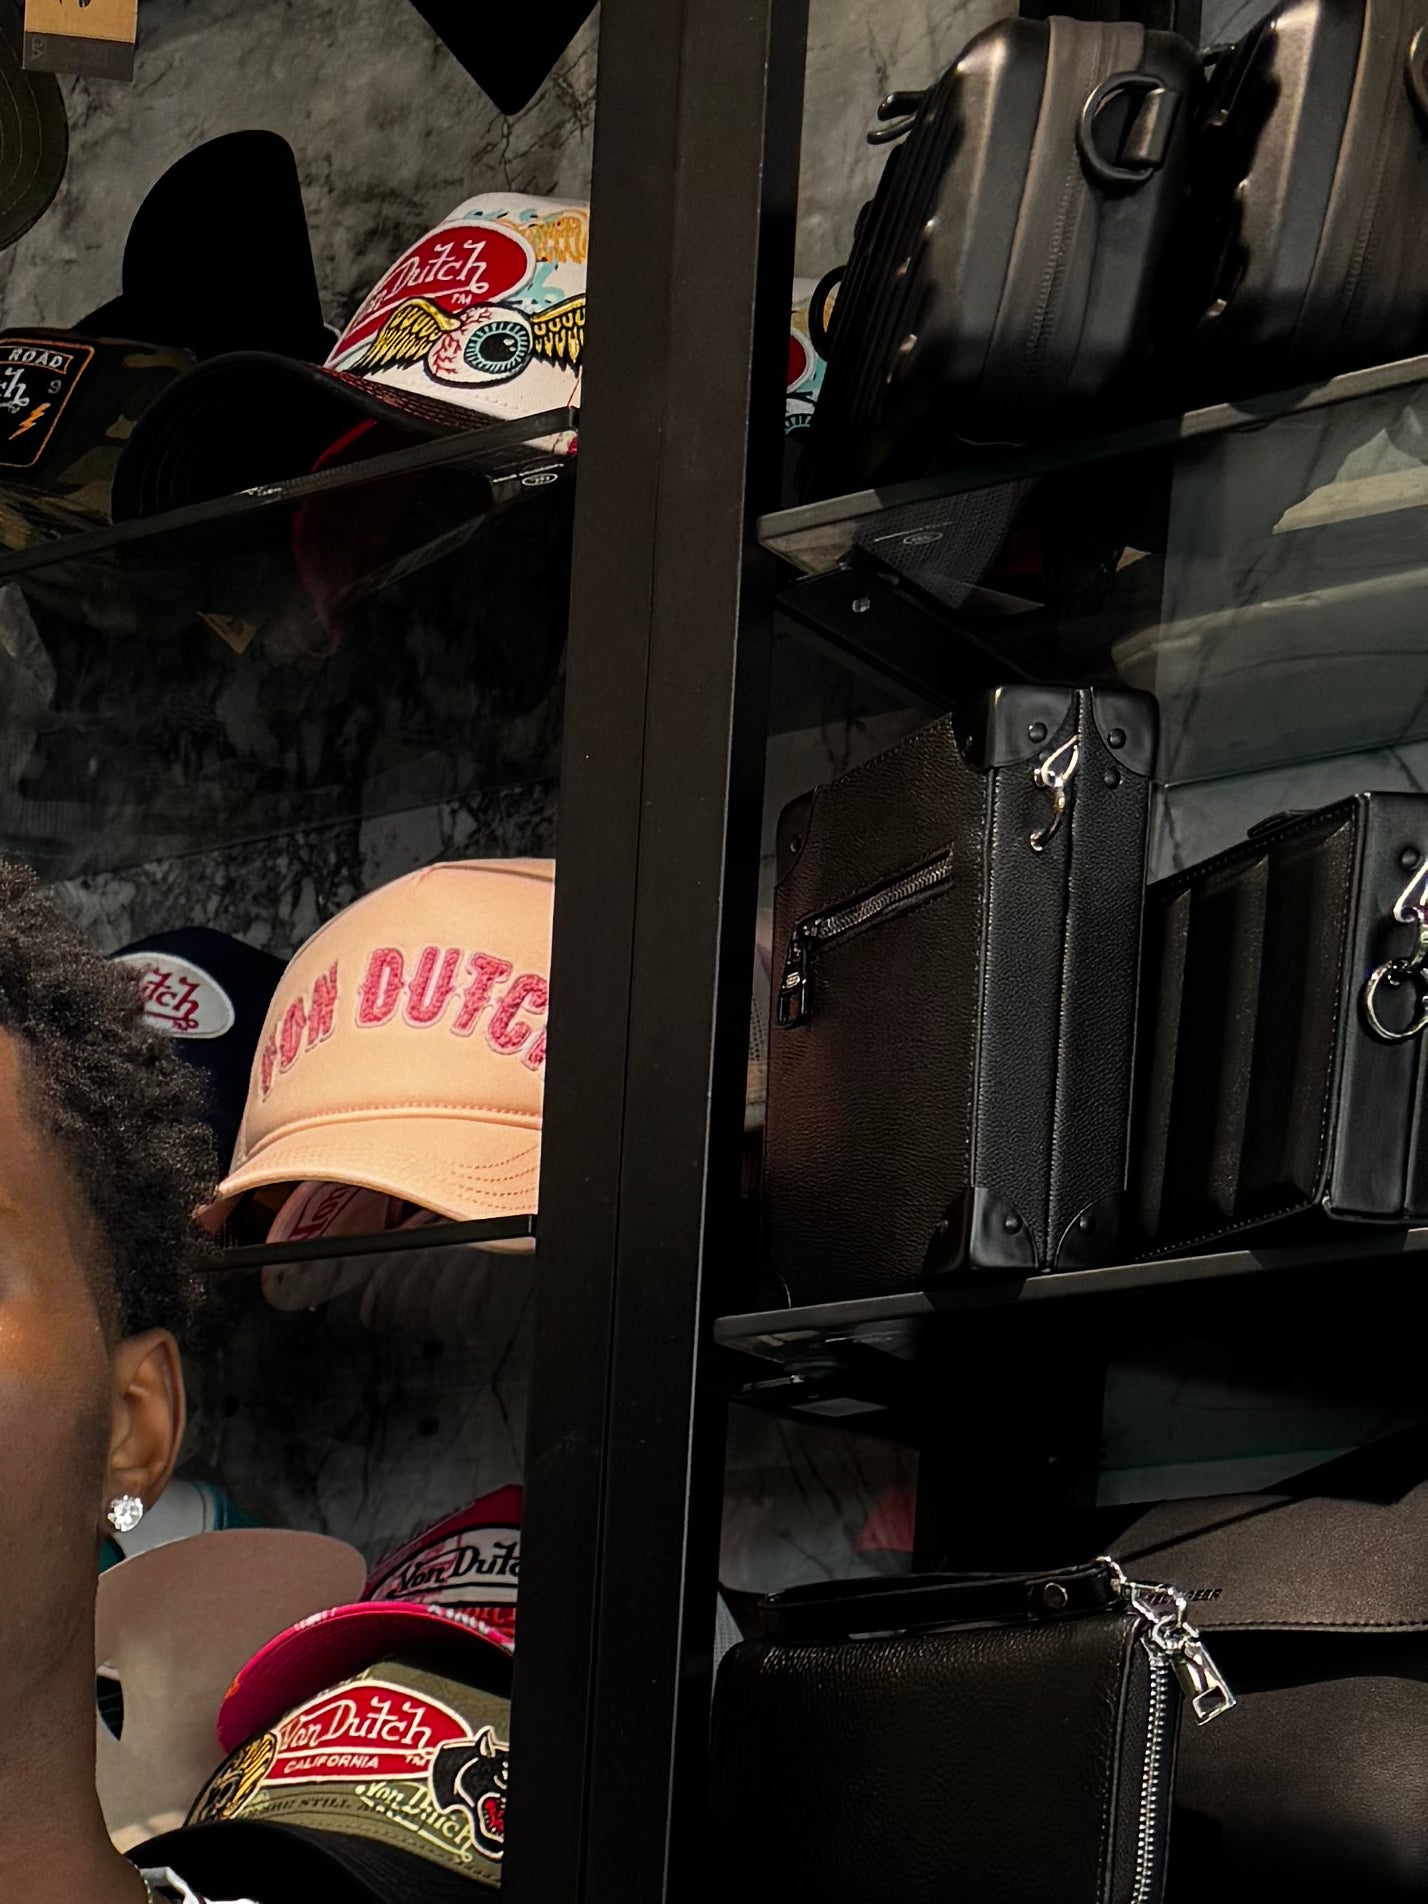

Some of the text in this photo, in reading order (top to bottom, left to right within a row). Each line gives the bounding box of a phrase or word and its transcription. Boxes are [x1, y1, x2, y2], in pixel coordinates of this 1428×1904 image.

[388, 239, 491, 296] Dutch
[7, 348, 64, 369] ROAD
[143, 967, 201, 1021] tch
[397, 1562, 447, 1592] Von
[279, 1696, 438, 1754] Von Dutch
[282, 1754, 380, 1774] CALIFORNIA
